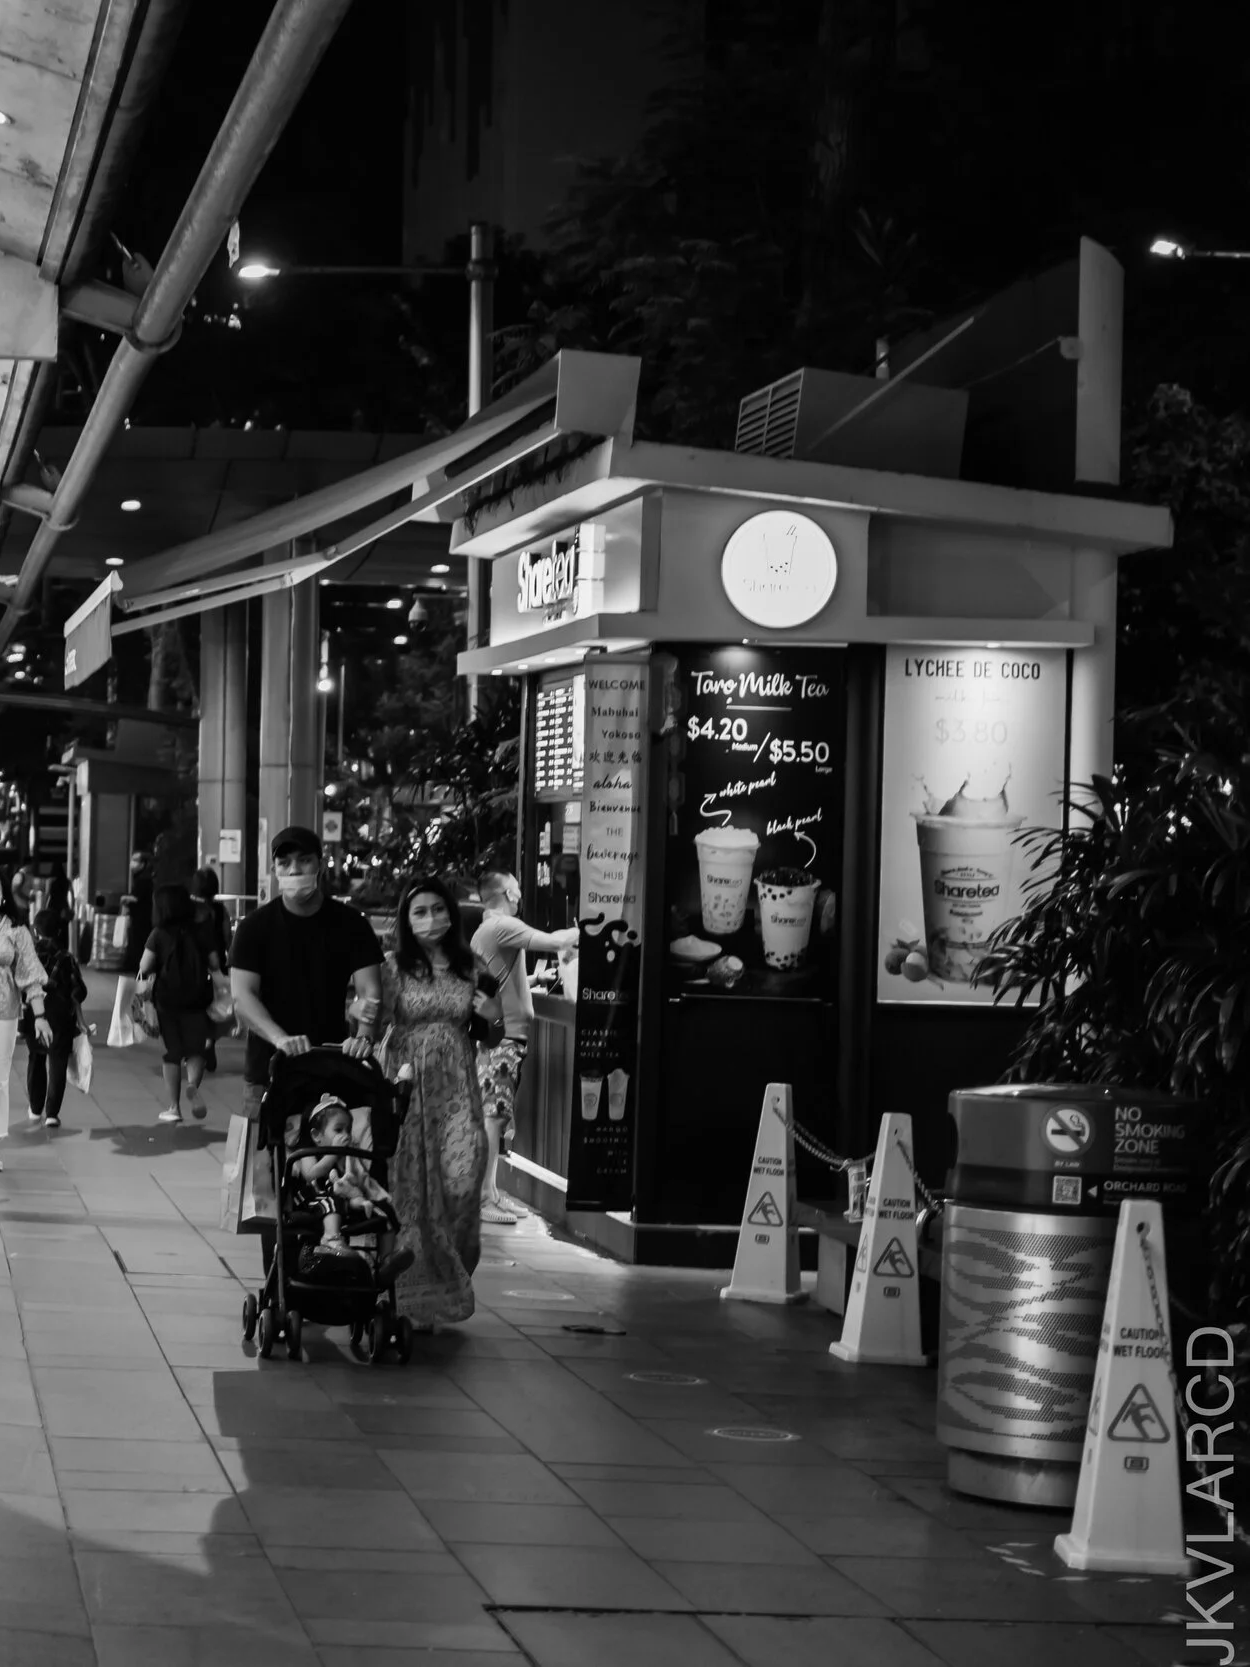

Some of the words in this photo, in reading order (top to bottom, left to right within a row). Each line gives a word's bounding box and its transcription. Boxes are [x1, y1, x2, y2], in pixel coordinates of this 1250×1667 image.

[904, 658, 965, 678] LYCHEE
[973, 660, 993, 679] DE
[1001, 662, 1041, 681] COCO
[588, 680, 646, 691] WELCOME
[690, 670, 738, 697] Taro
[738, 671, 793, 698] Milk
[795, 674, 829, 699] Tea
[602, 729, 641, 740] Yokoso
[687, 715, 748, 741] $4.20
[935, 717, 1008, 745] $380
[732, 742, 758, 752] Medium
[769, 738, 830, 764] $5.50
[593, 773, 633, 790] aloha
[719, 780, 747, 797] white
[747, 770, 776, 795] pearl
[589, 800, 642, 814] Bienvenue
[766, 815, 794, 836] black
[795, 807, 822, 831] pearl
[606, 826, 624, 837] THE
[586, 842, 640, 866] beverage
[603, 870, 624, 881] HUB
[934, 879, 1000, 899] Sharetea
[1114, 1106, 1142, 1121] NO
[1114, 1122, 1186, 1139] SMOKING
[1114, 1139, 1159, 1154] ZONE
[757, 1156, 783, 1166] CAUTION
[753, 1166, 765, 1175] WET
[766, 1167, 785, 1176] FLOOR
[1103, 1180, 1161, 1193] ORCHARD
[883, 1198, 911, 1208] CAUTION
[878, 1210, 892, 1219] WET
[893, 1211, 915, 1220] FLOOR
[1113, 1345, 1133, 1357] WET
